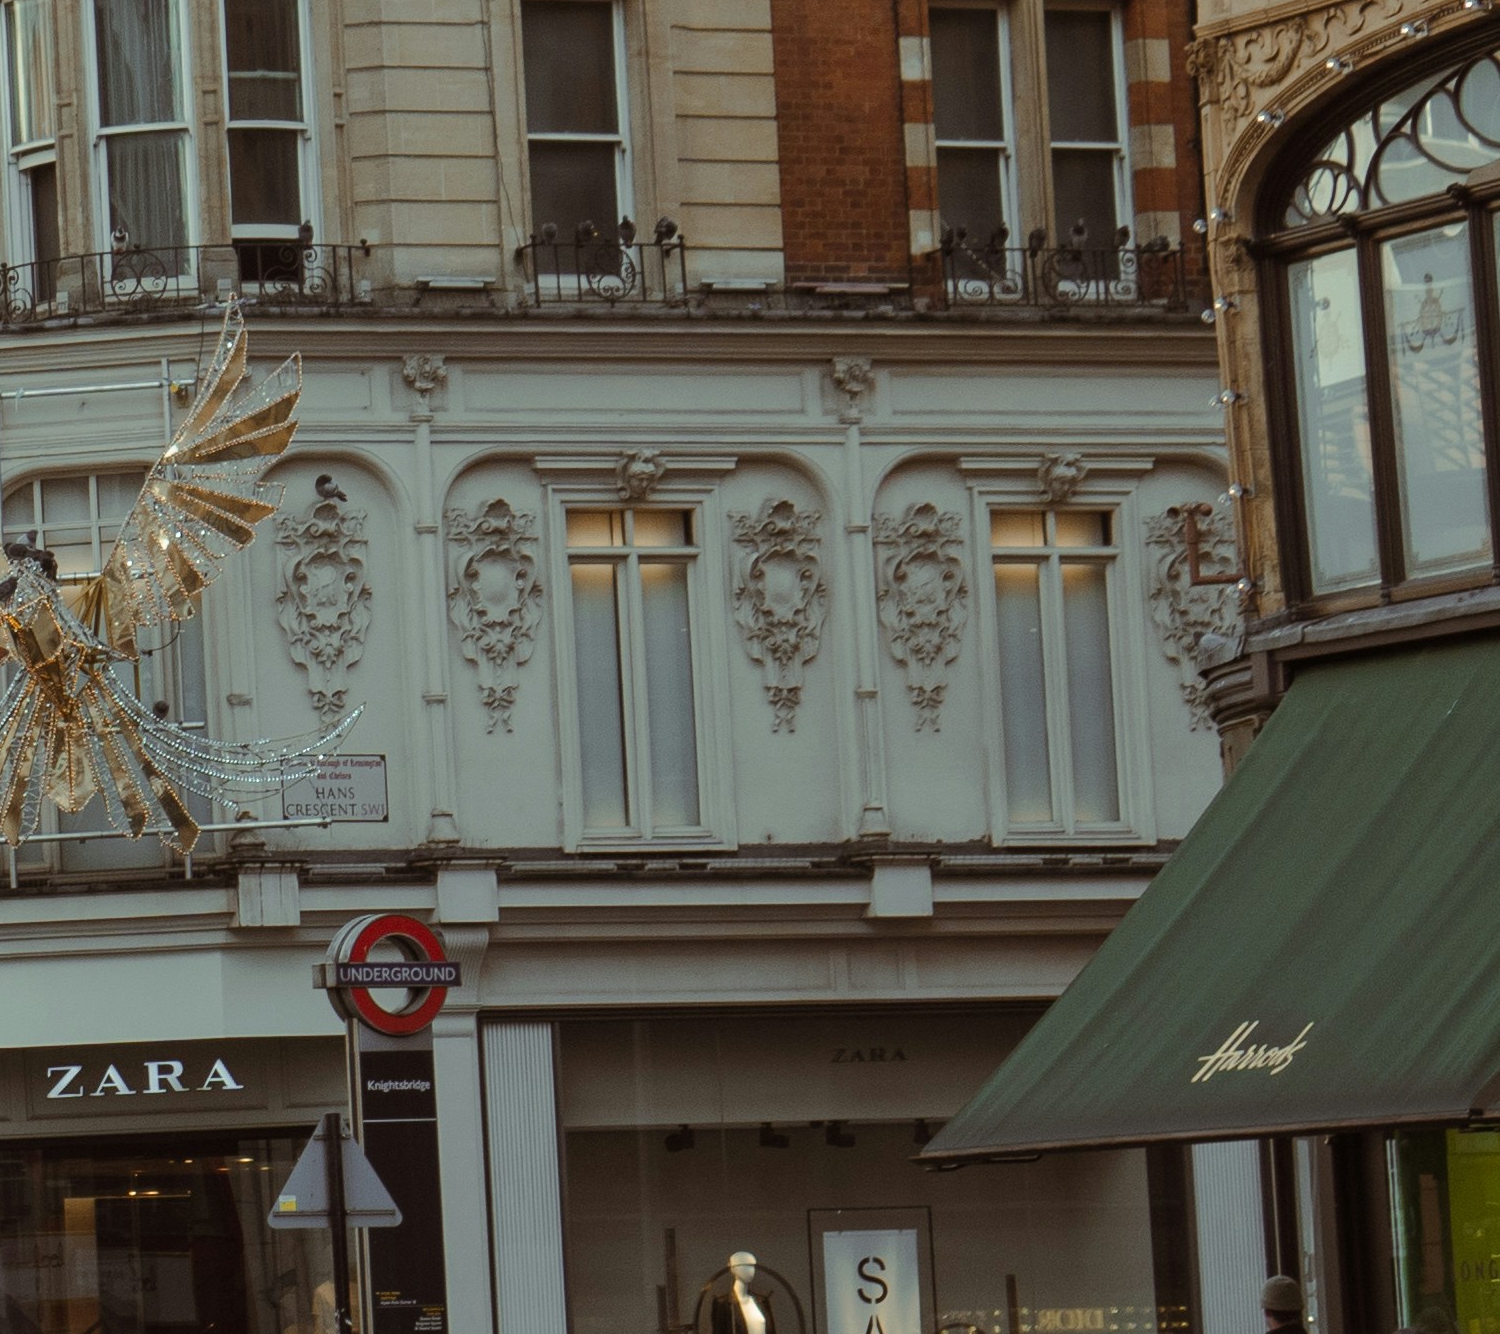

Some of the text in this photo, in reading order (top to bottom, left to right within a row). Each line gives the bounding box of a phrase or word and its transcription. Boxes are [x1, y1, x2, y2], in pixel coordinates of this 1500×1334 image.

[315, 786, 355, 799] HANS
[339, 966, 457, 982] UNDERGROUND
[831, 1047, 909, 1063] ZARA
[1191, 1020, 1315, 1083] Harrods
[47, 1058, 244, 1099] ZARA
[367, 1079, 431, 1093] Knightsbridge
